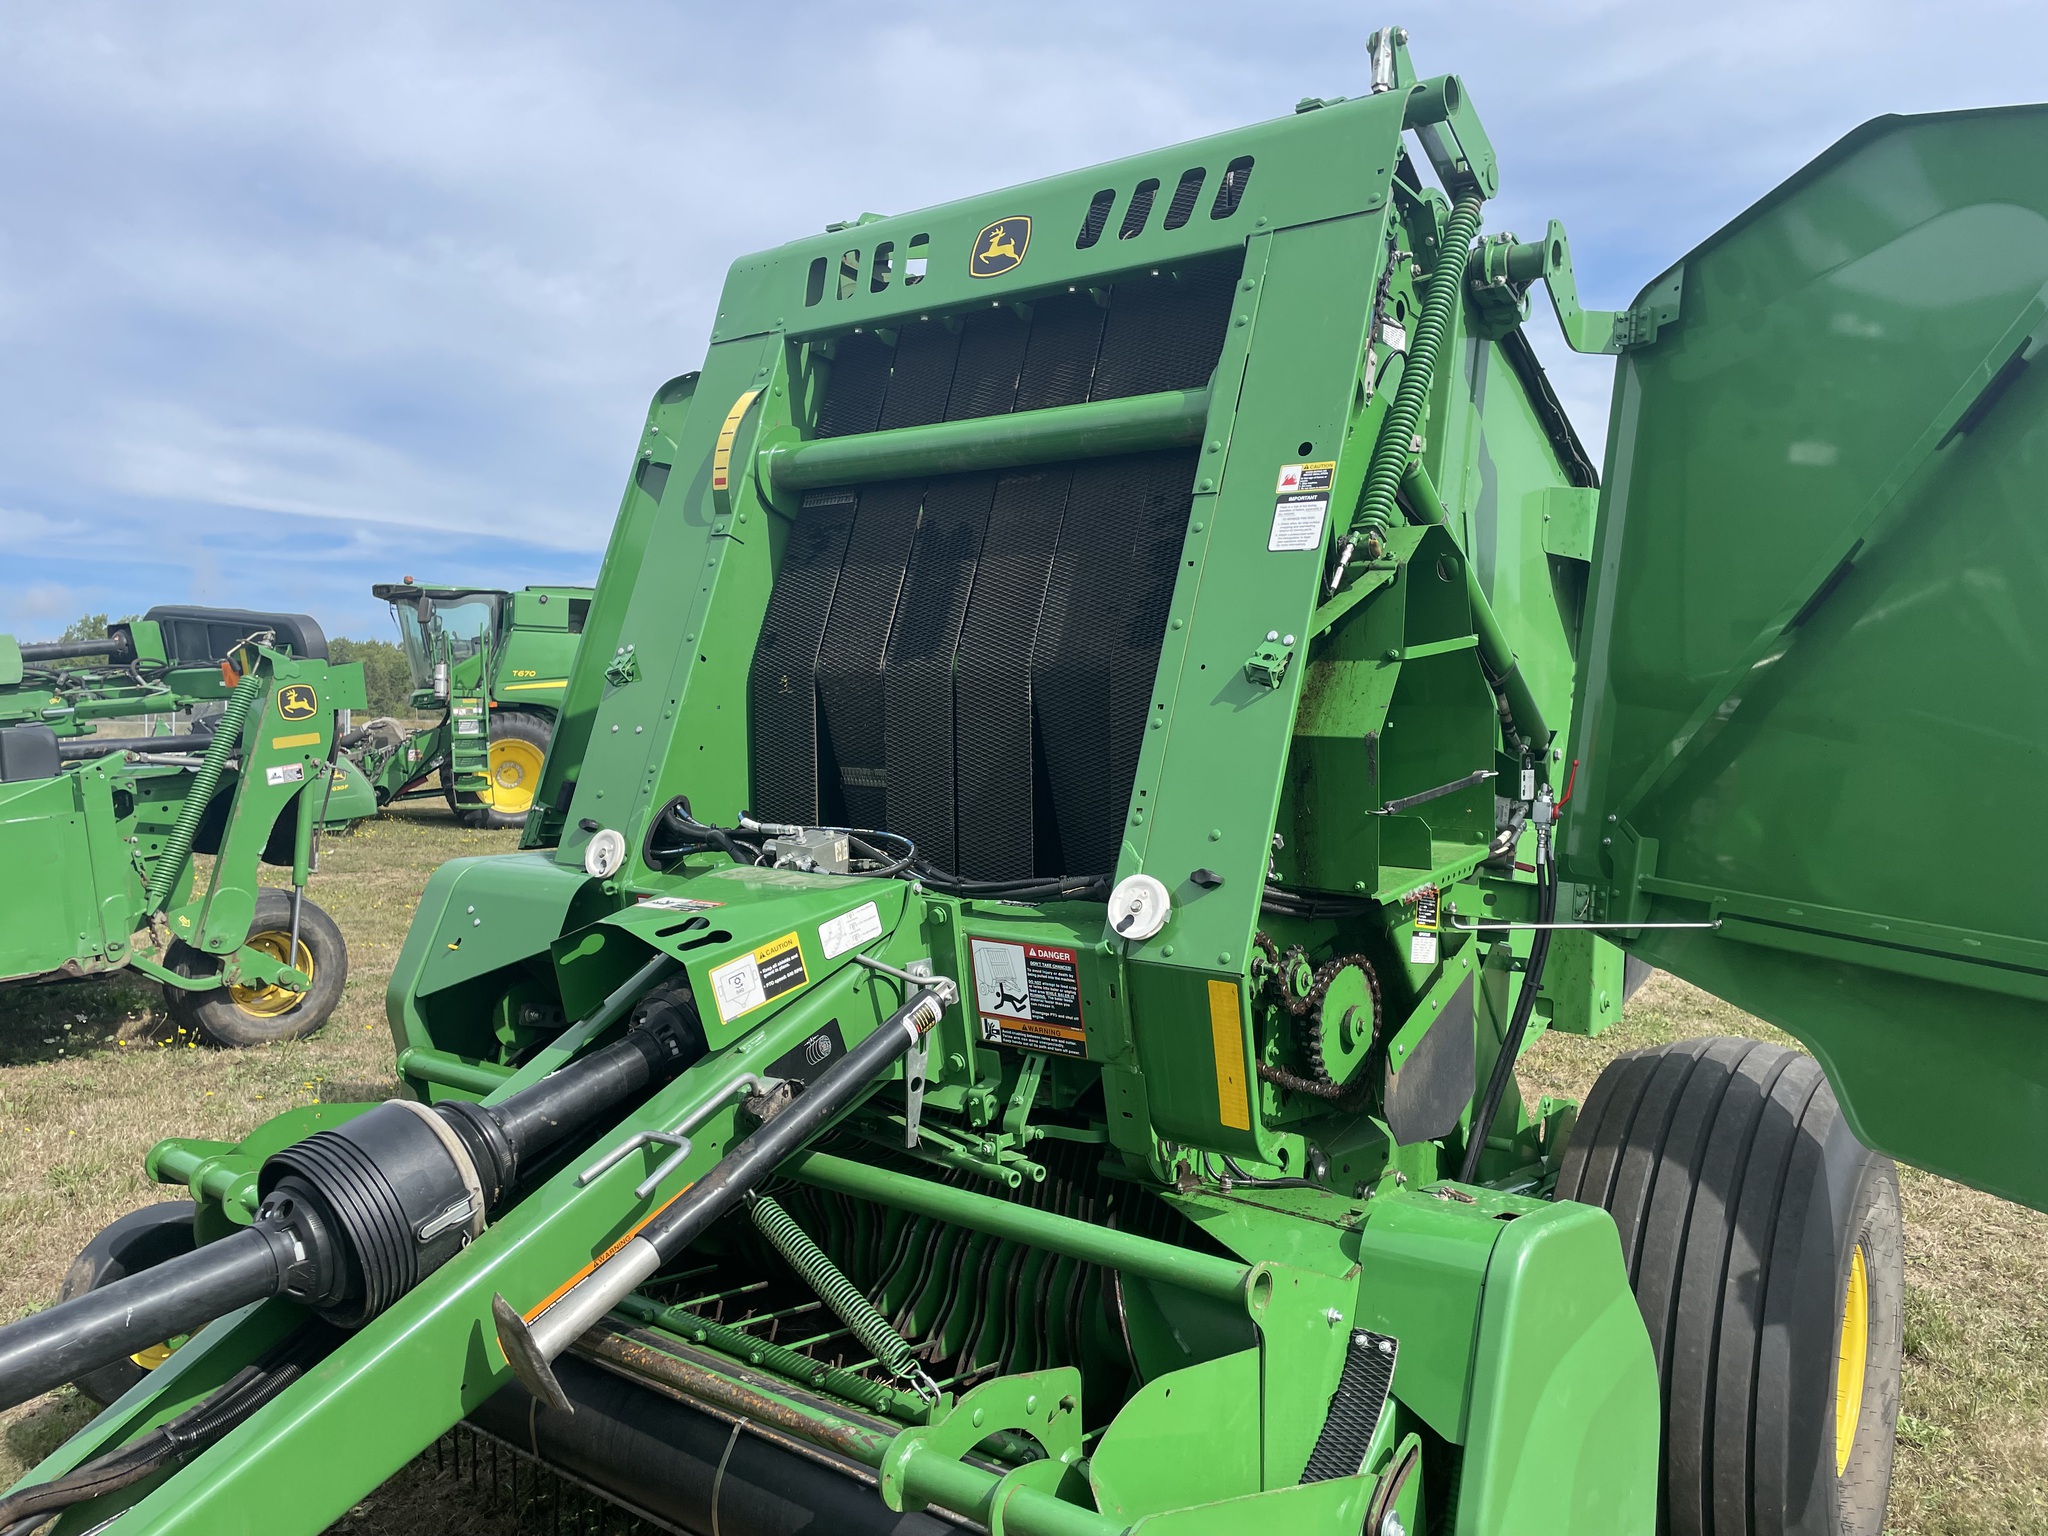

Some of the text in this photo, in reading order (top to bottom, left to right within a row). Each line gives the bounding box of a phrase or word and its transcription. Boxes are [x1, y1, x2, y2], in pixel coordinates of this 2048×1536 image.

[766, 939, 793, 956] CAUTION
[1038, 950, 1070, 961] DANGER
[1028, 1025, 1061, 1036] WARNING
[598, 1235, 631, 1263] WARNING
